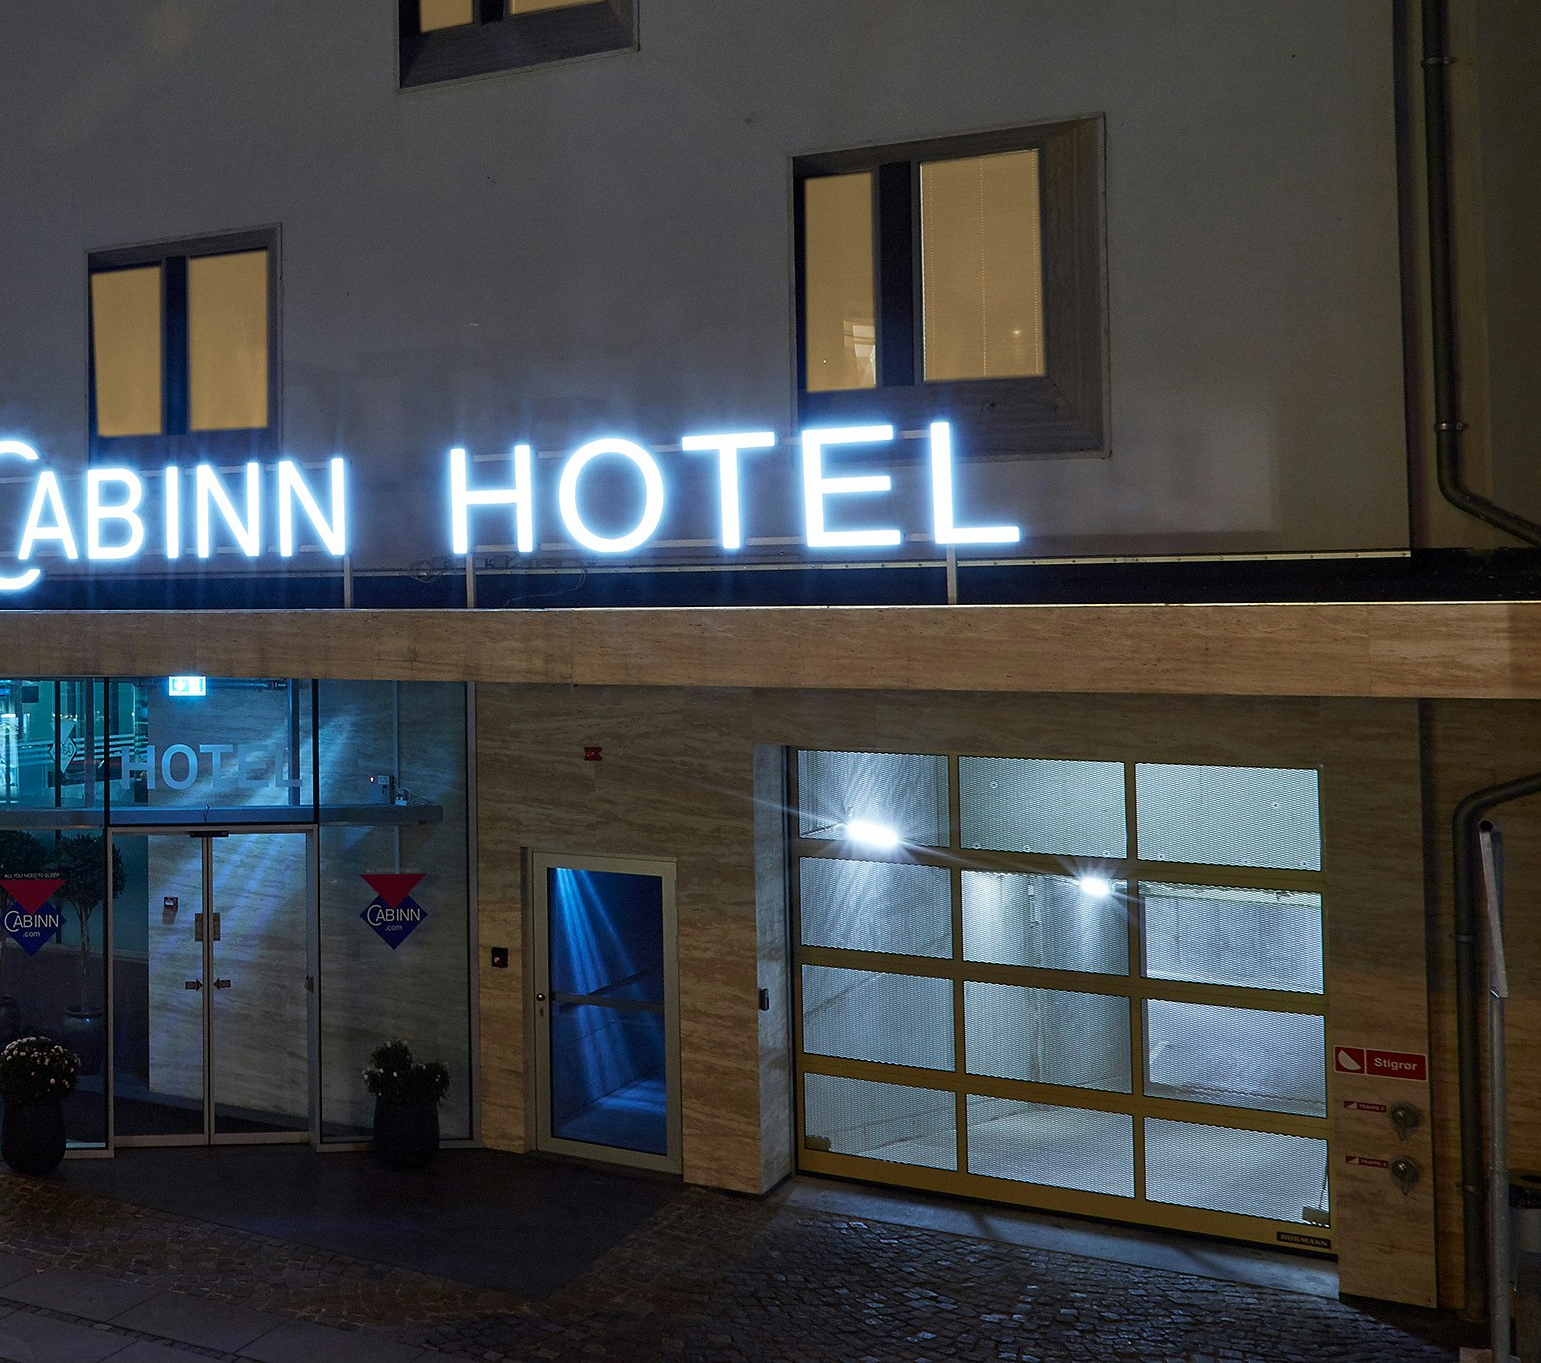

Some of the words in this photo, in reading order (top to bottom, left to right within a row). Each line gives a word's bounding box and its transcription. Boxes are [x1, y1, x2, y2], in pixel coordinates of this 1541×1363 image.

[449, 421, 1021, 555] HOTEL
[121, 743, 303, 790] HOTEL
[3, 909, 60, 933] CABINN
[366, 904, 421, 927] CABINN
[384, 924, 403, 932] .com
[1373, 1057, 1419, 1072] Stigror
